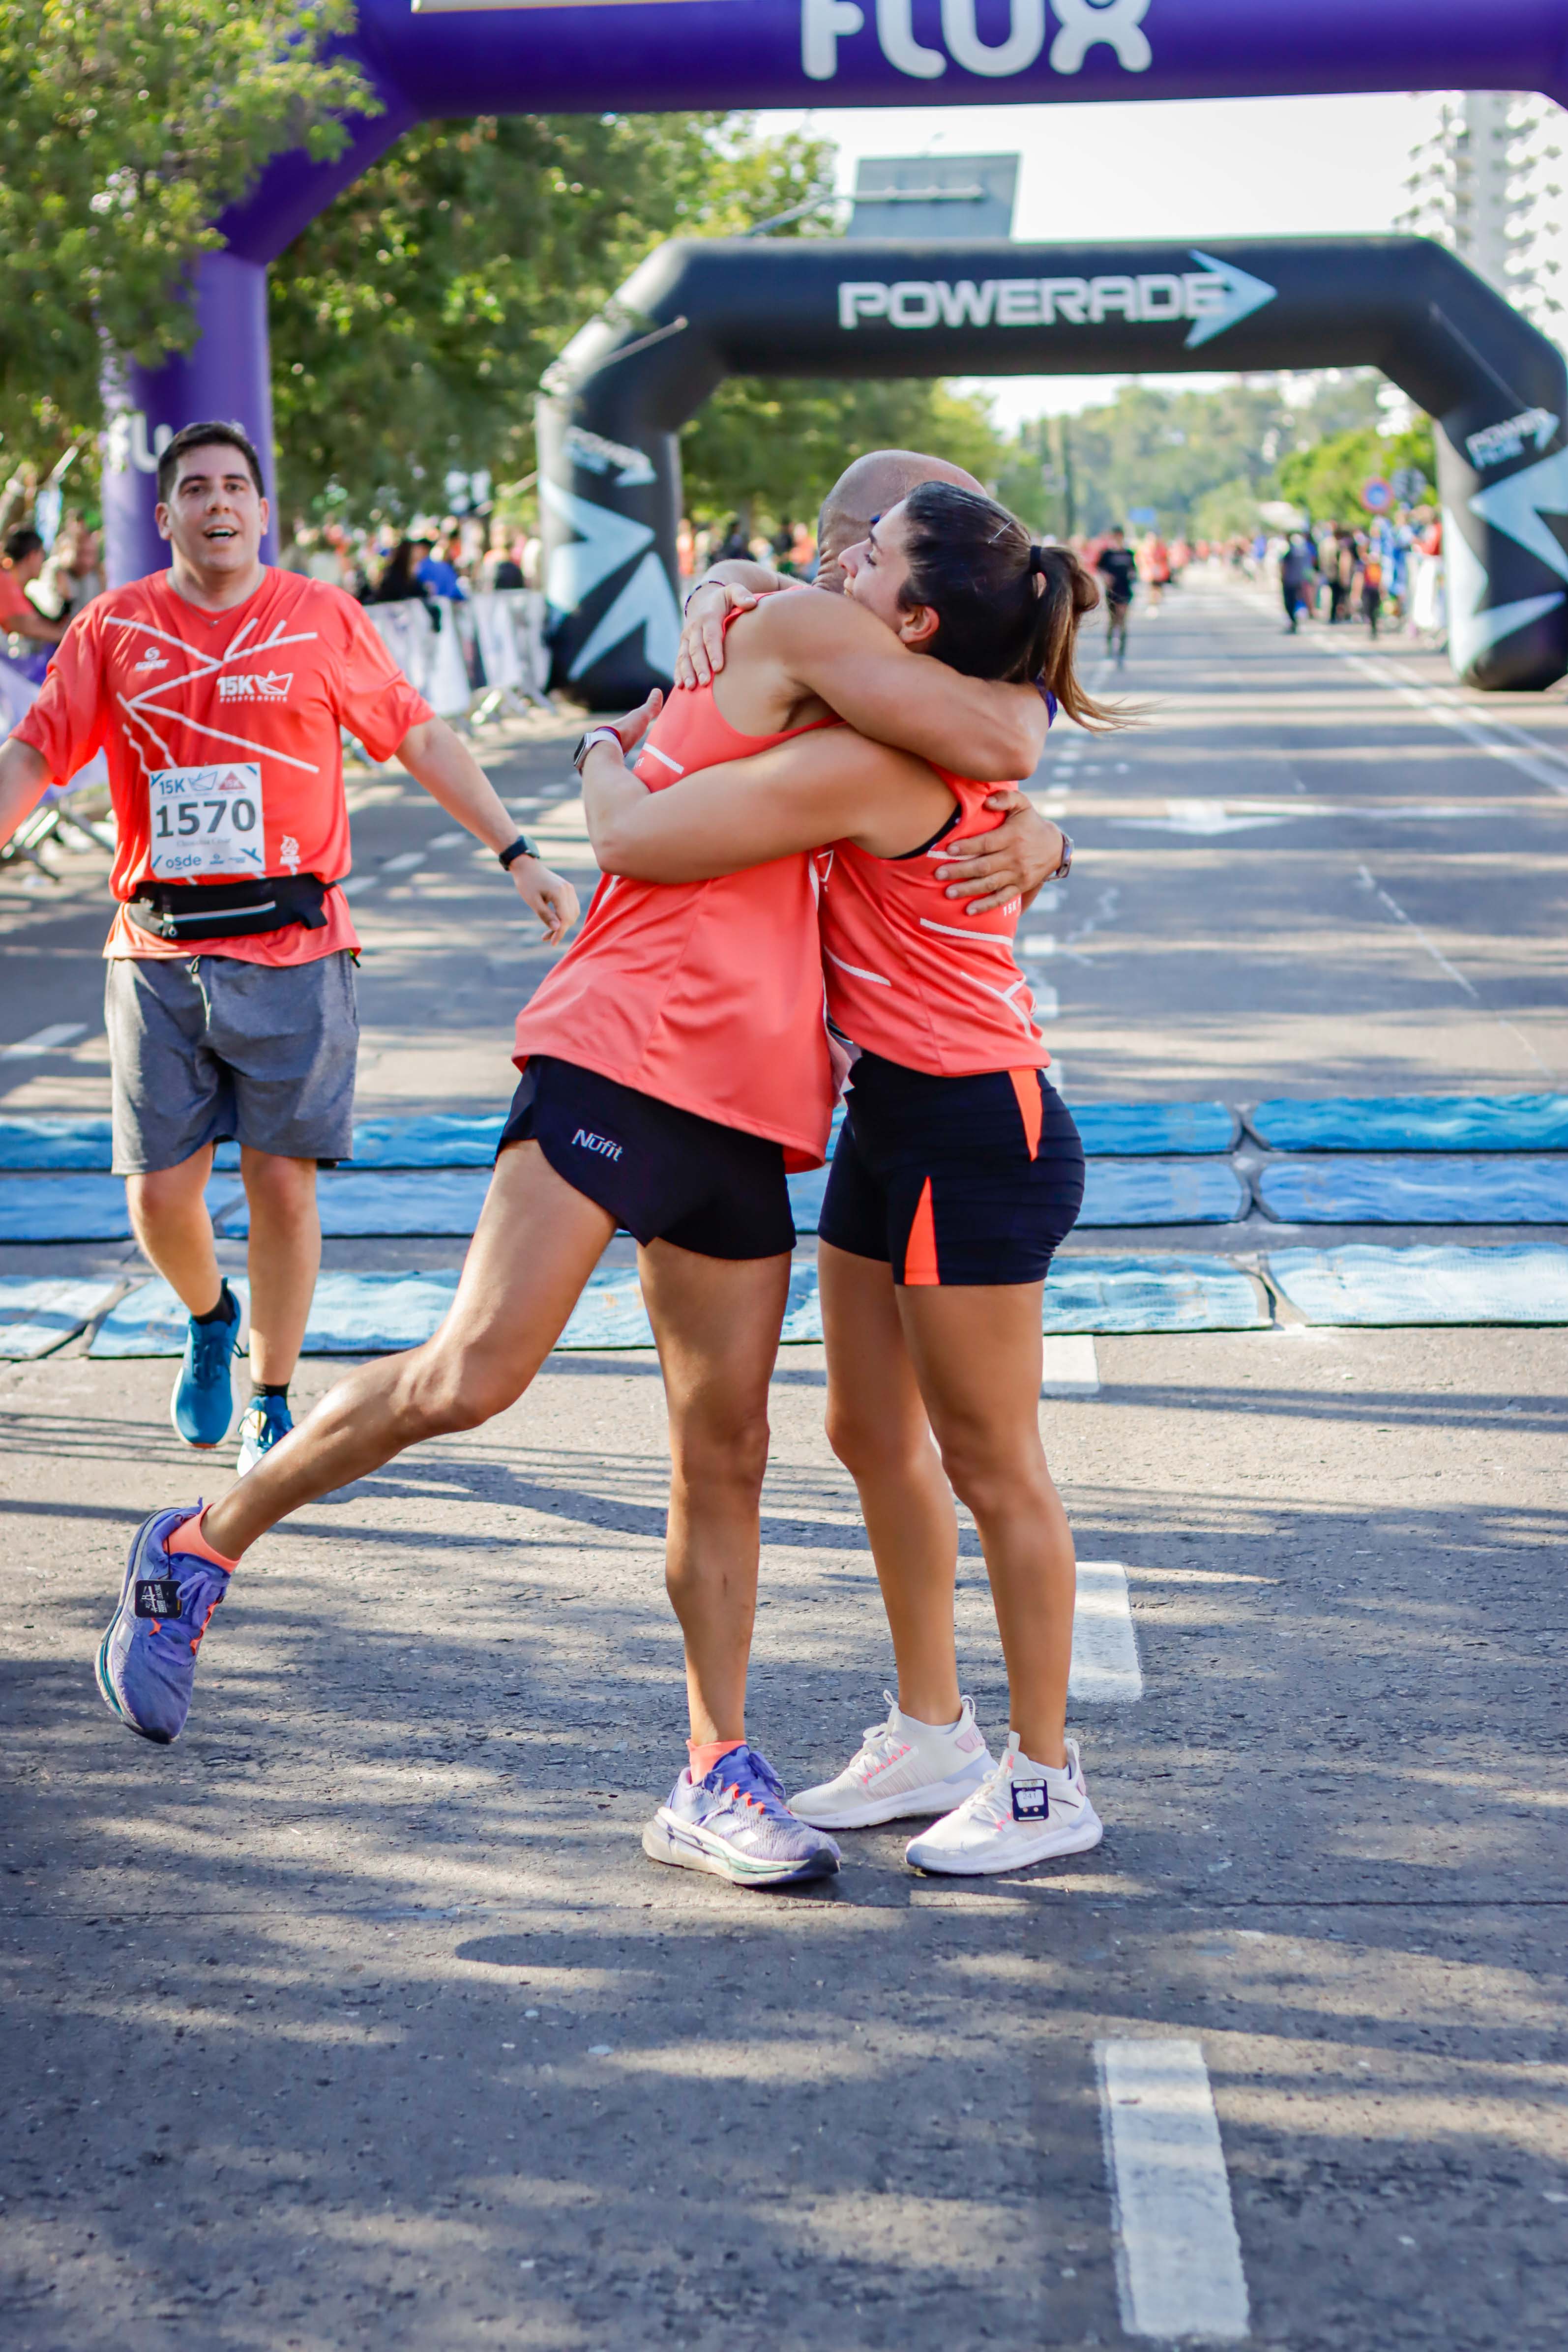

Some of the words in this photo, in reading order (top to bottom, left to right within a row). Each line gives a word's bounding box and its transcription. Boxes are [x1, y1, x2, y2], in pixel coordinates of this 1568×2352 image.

[800, 0, 1153, 81] FLUX
[838, 271, 1225, 329] POWERADE
[217, 674, 255, 697] 15K
[159, 778, 185, 795] 15K
[155, 798, 256, 838] 1570
[165, 853, 202, 870] osde
